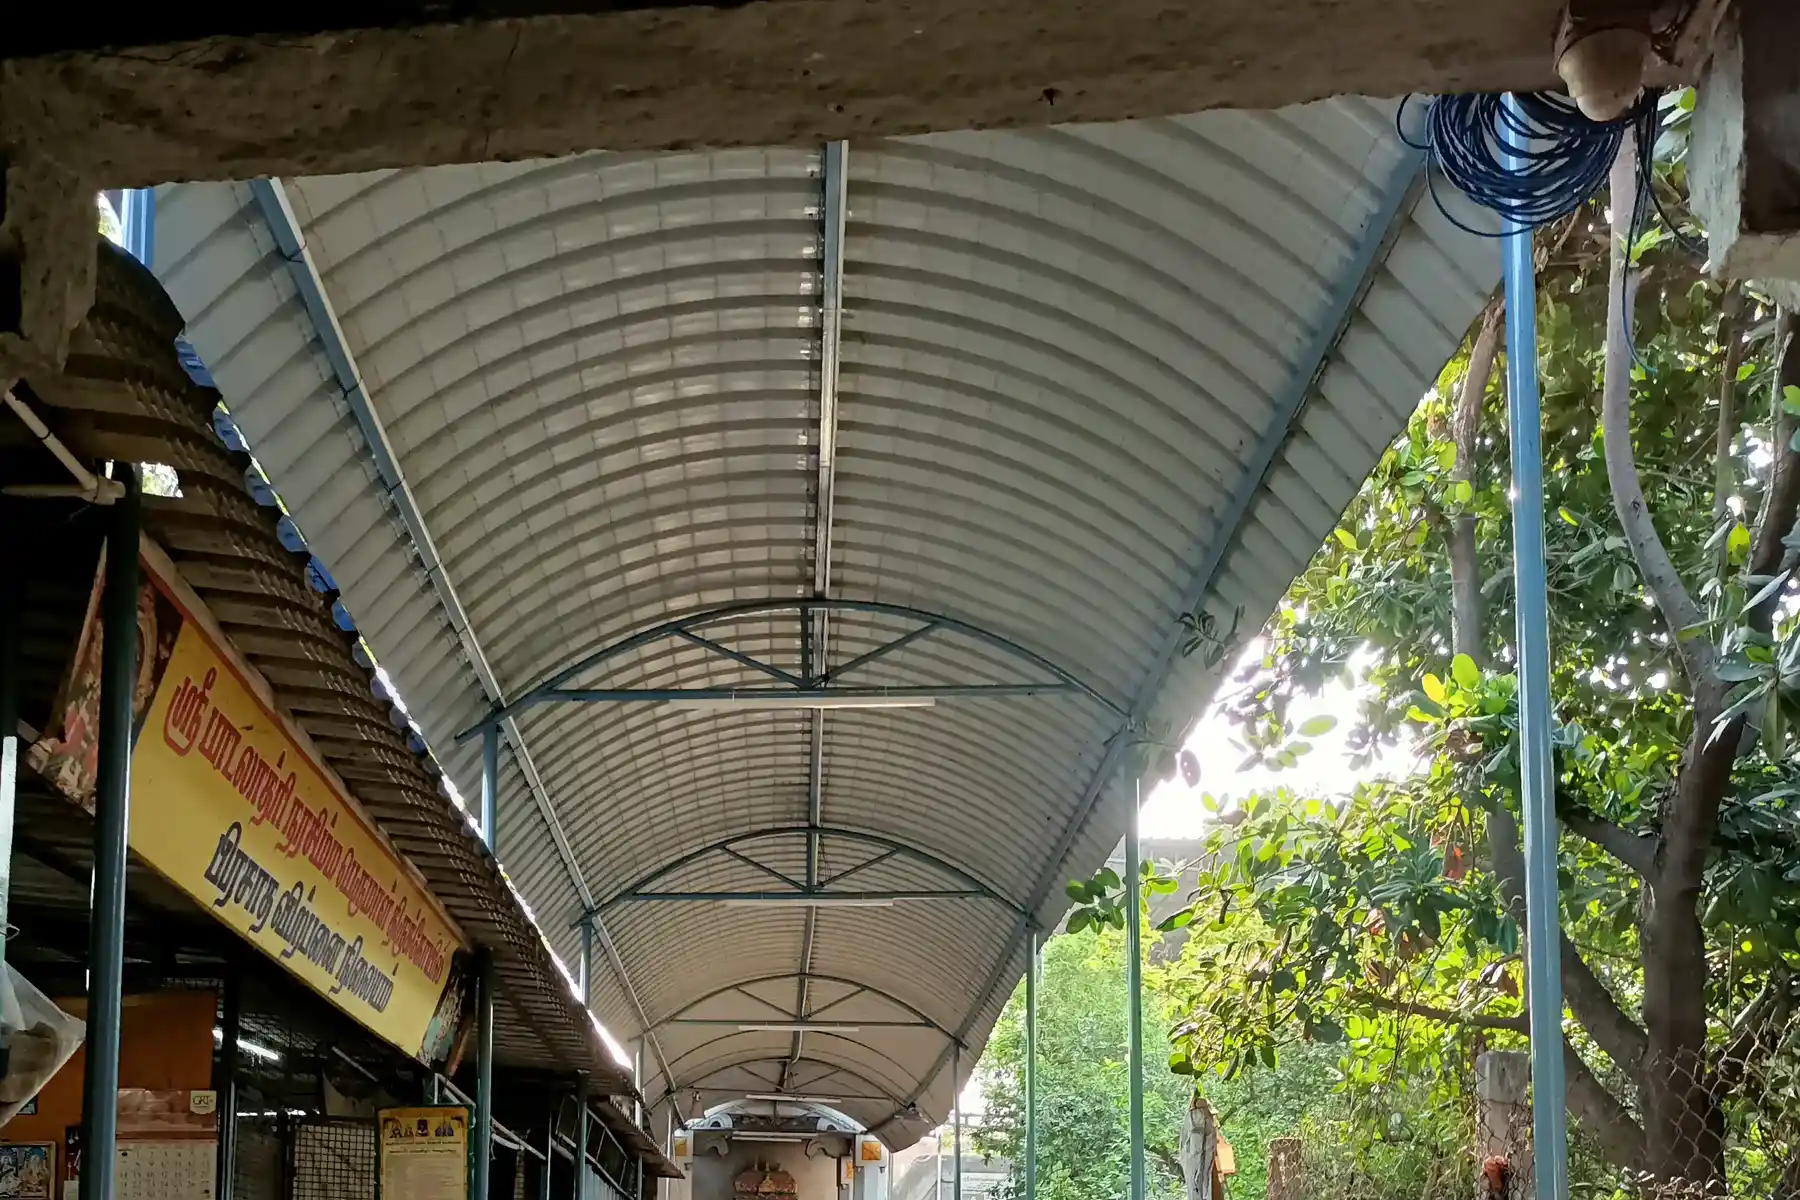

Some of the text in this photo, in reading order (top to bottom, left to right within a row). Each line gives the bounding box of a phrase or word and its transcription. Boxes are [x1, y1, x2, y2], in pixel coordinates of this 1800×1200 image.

[163, 666, 217, 756] ஸ்ரீ
[335, 847, 397, 931] பெருமாள்
[204, 821, 399, 1013] பிரசாத விற்பனை நிலையம்
